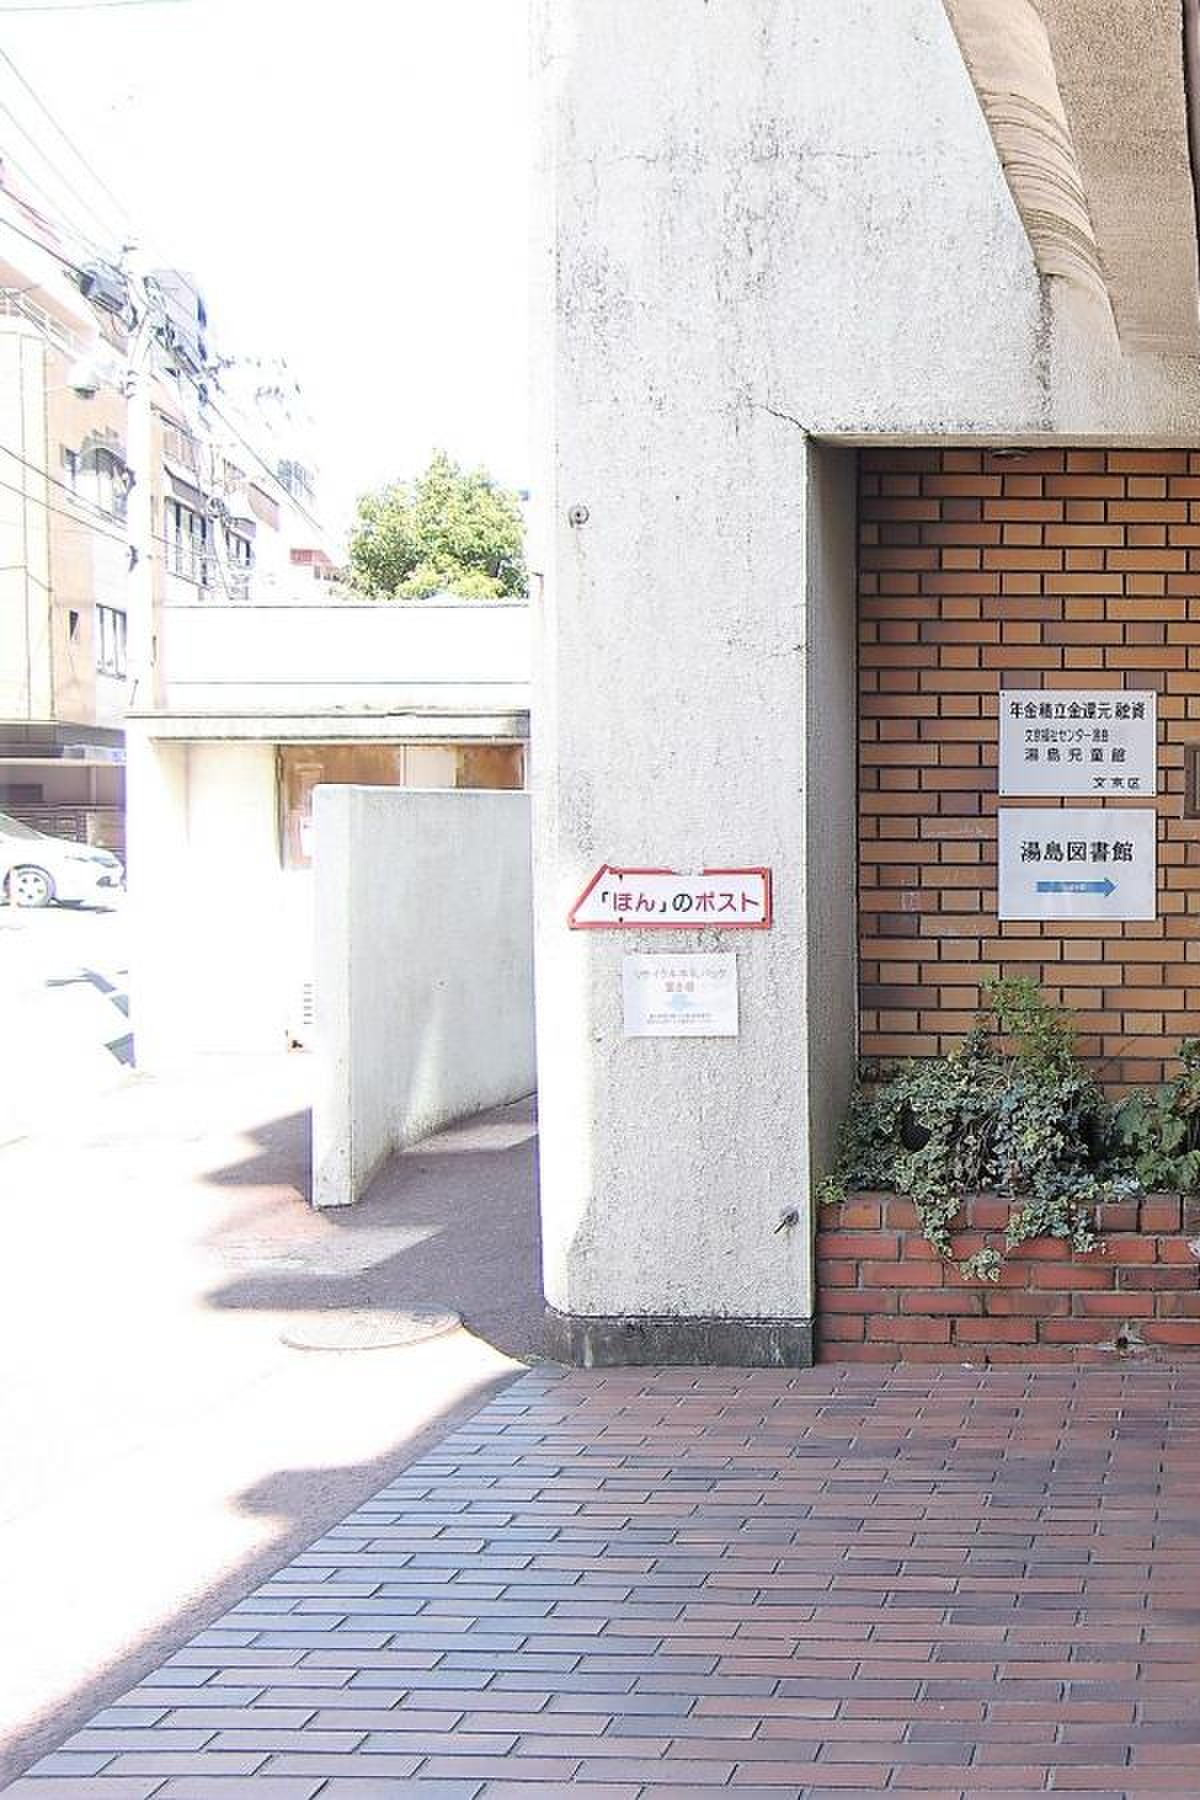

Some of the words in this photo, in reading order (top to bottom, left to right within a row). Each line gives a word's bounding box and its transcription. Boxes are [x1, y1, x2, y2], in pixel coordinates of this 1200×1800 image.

[1021, 841, 1134, 862] 湯島図書館
[601, 891, 760, 912] 「ほん」のポスト
